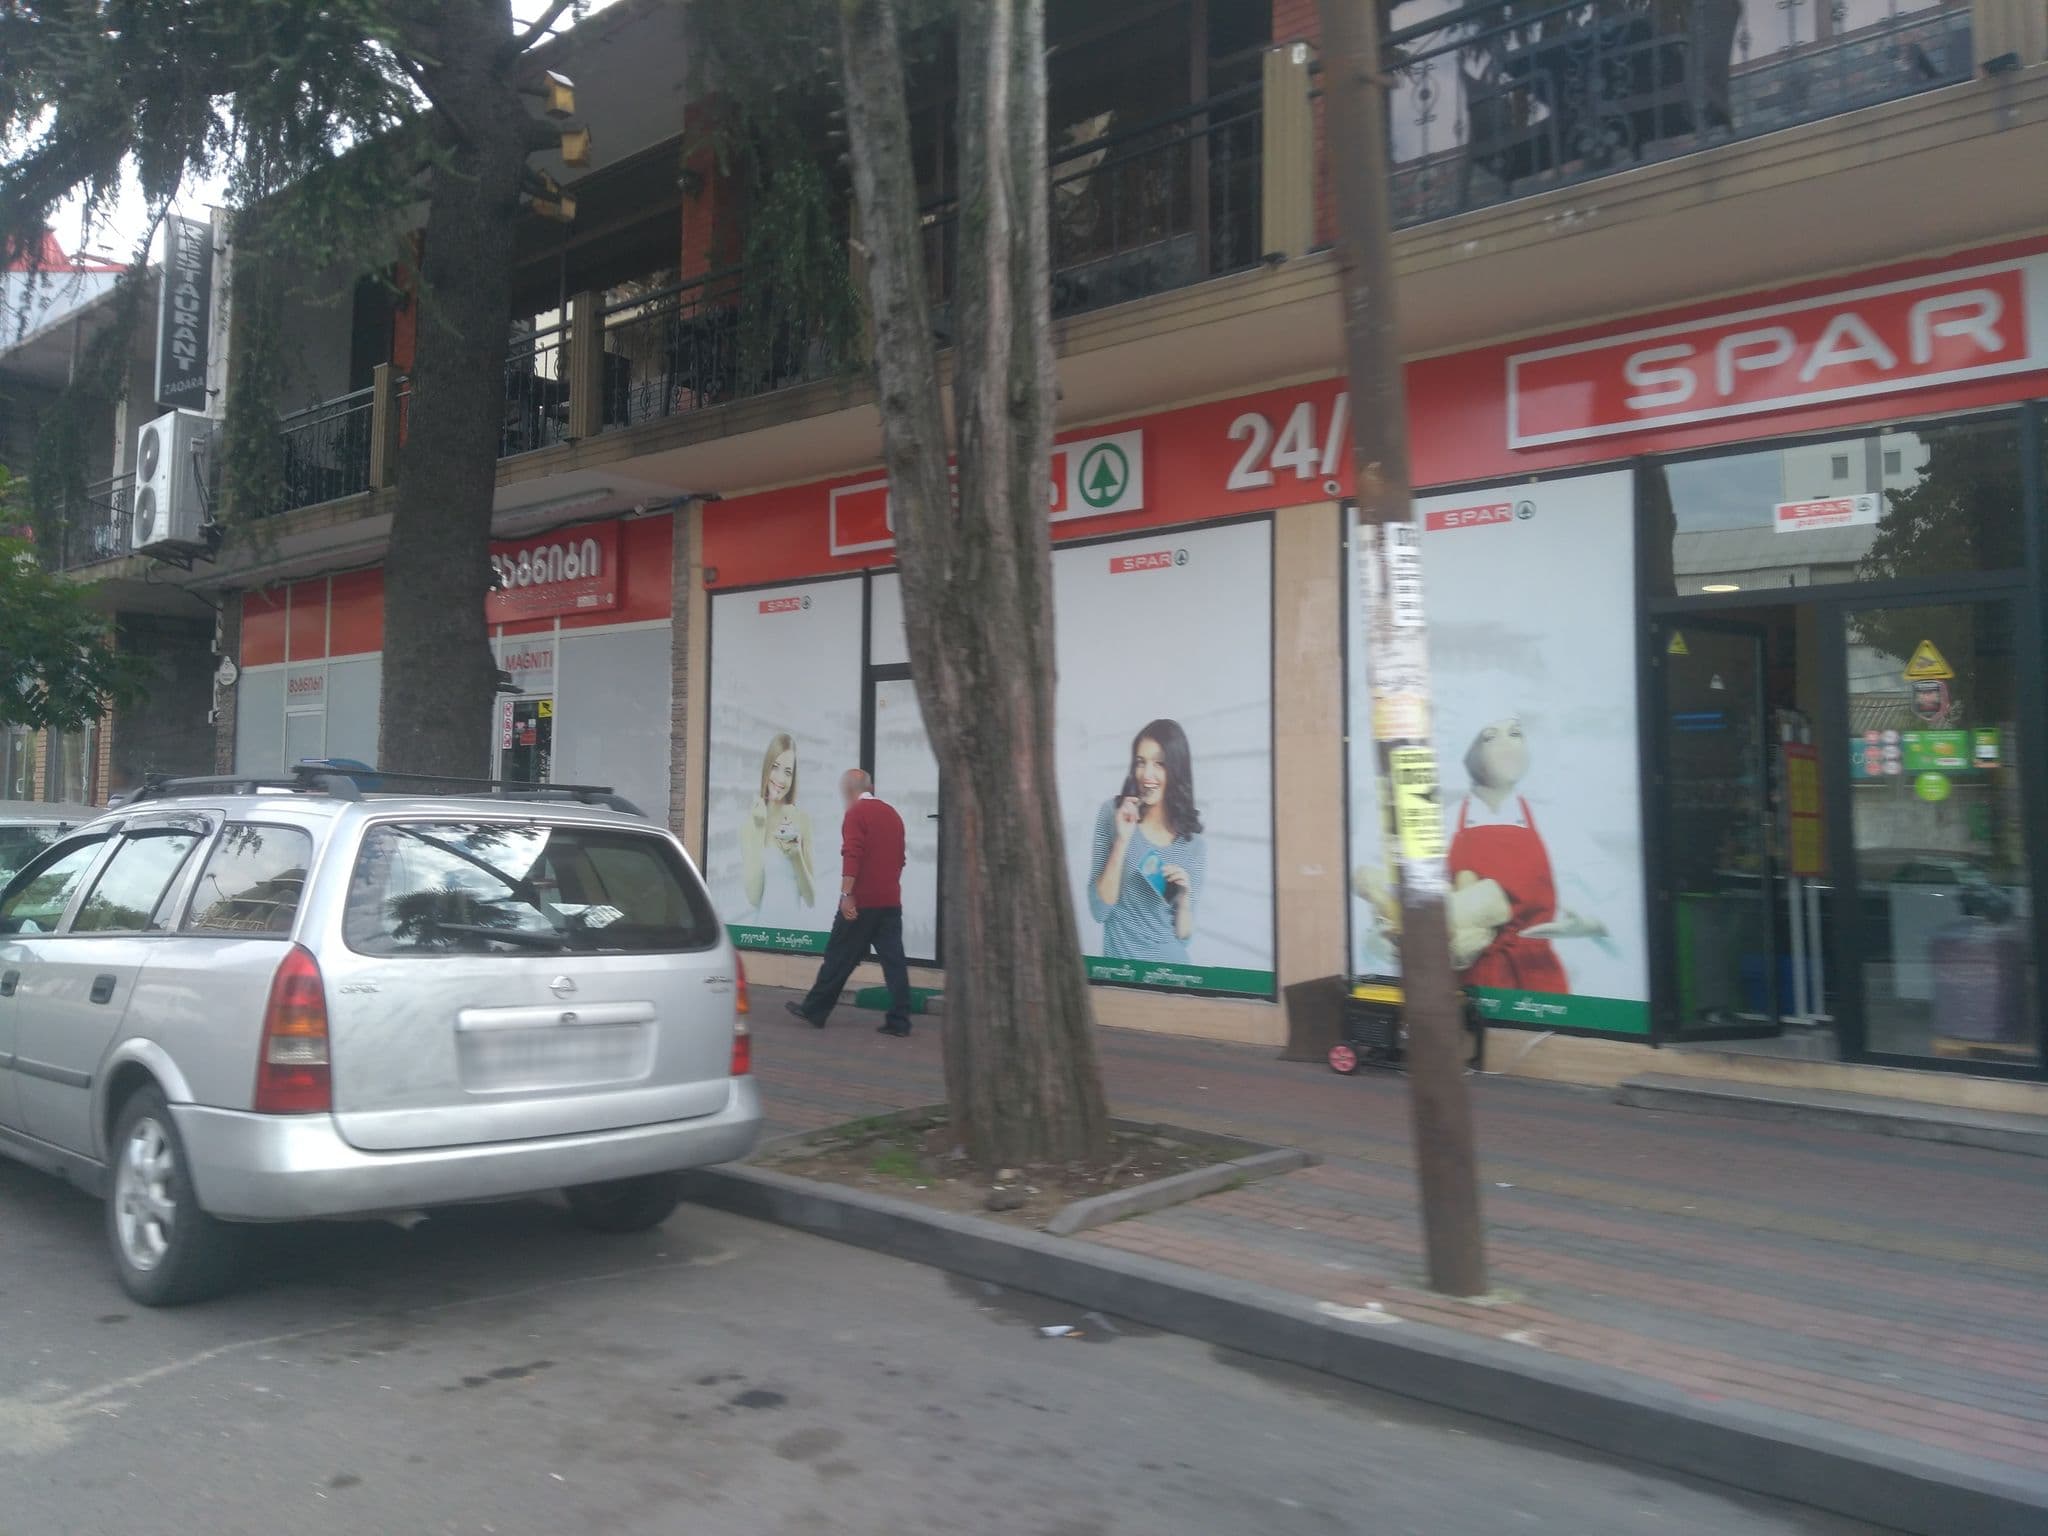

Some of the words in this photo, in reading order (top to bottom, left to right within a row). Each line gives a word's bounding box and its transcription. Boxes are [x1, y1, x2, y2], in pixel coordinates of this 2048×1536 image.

[174, 222, 205, 371] RESTAURANT
[1624, 287, 2006, 411] SPAR
[1226, 391, 1350, 491] 24/
[1444, 506, 1512, 526] SPAR
[1795, 501, 1853, 517] SPAR
[1123, 553, 1171, 570] SPAR
[767, 599, 800, 612] SPAR
[505, 651, 553, 671] MAGNITI
